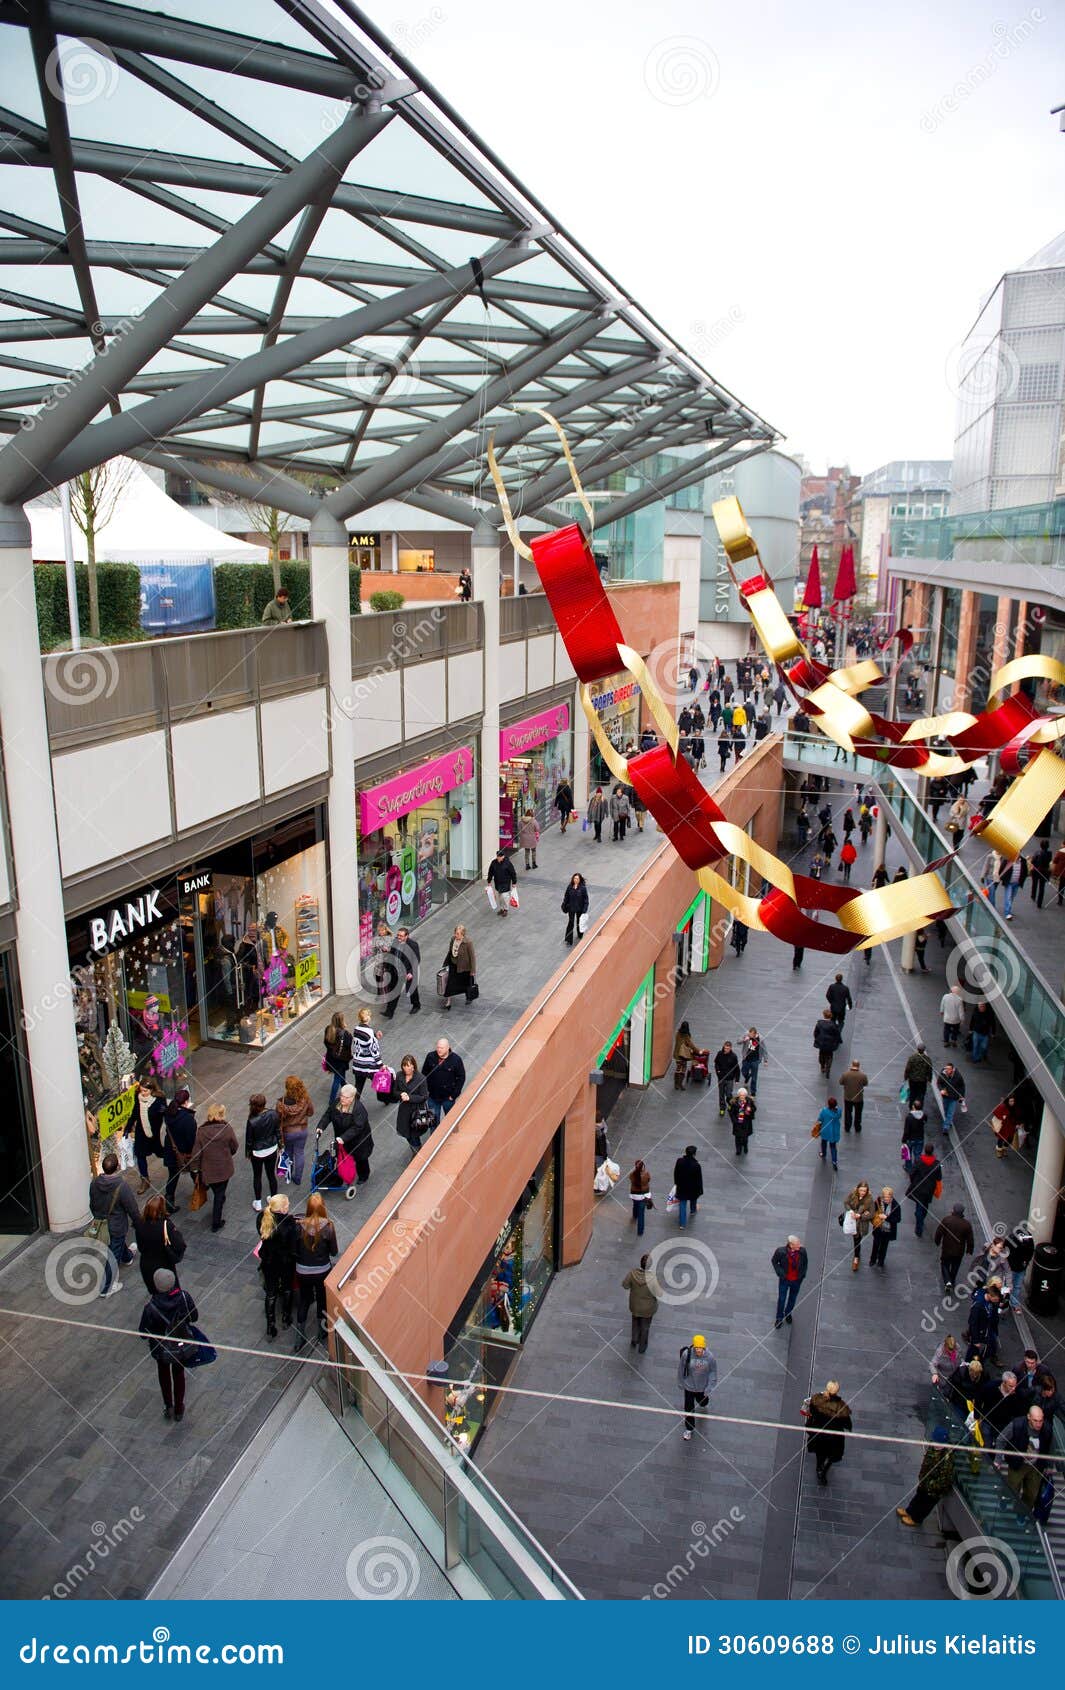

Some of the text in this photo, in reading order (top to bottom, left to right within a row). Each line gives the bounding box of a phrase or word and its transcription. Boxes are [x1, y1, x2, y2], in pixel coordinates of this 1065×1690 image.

[350, 535, 376, 546] AMS
[377, 775, 444, 818] Superdrug
[183, 874, 211, 894] BANK
[90, 889, 163, 952] BANK
